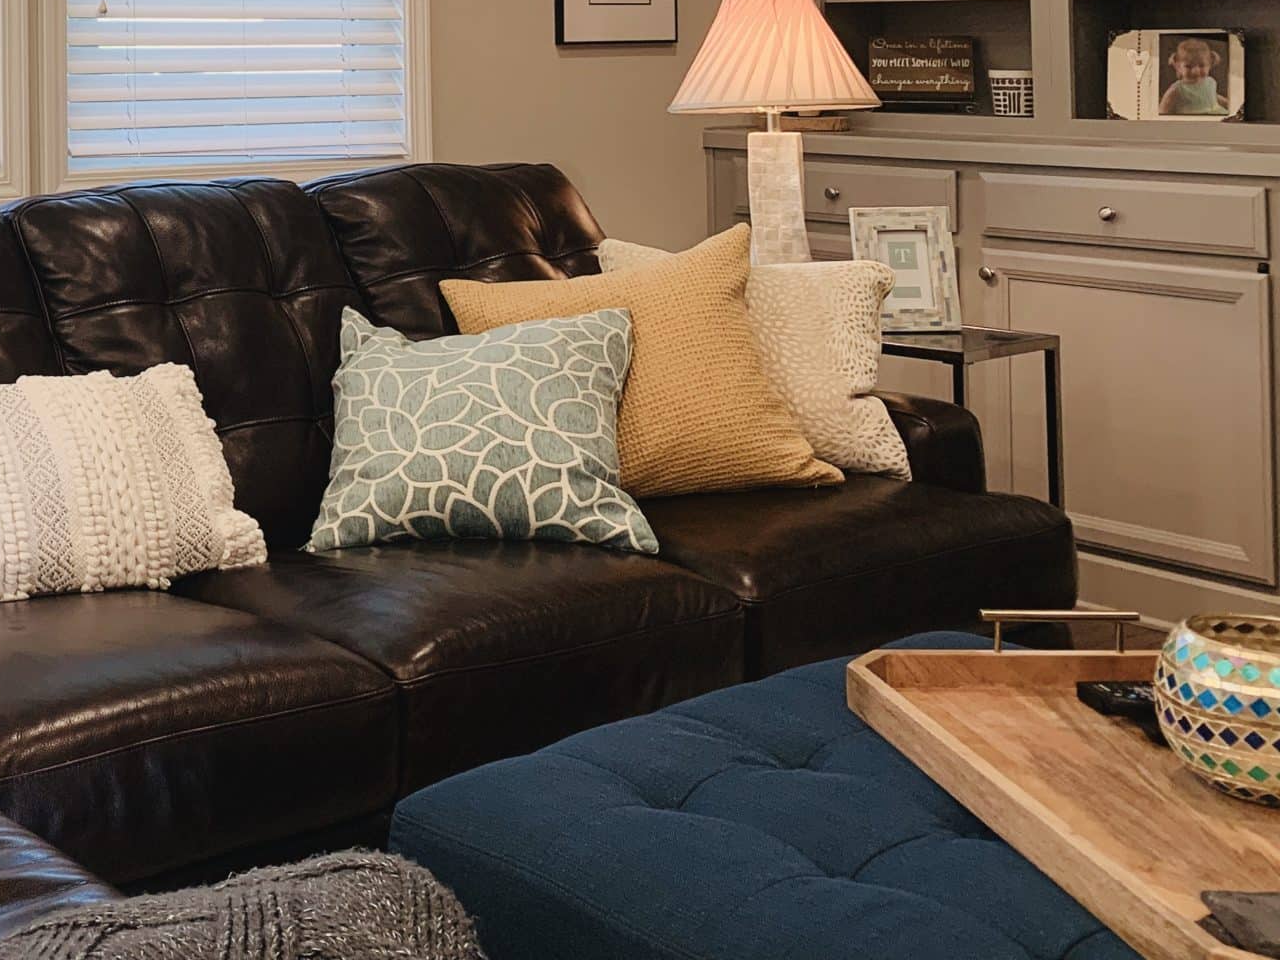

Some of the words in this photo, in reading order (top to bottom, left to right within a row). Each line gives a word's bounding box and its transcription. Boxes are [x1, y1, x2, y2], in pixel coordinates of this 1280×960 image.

[929, 38, 970, 54] lifetime
[872, 58, 888, 68] YOU
[889, 58, 910, 68] MEET
[950, 58, 970, 68] WHO
[872, 73, 913, 91] changes
[916, 73, 971, 91] everything
[894, 248, 910, 263] T
